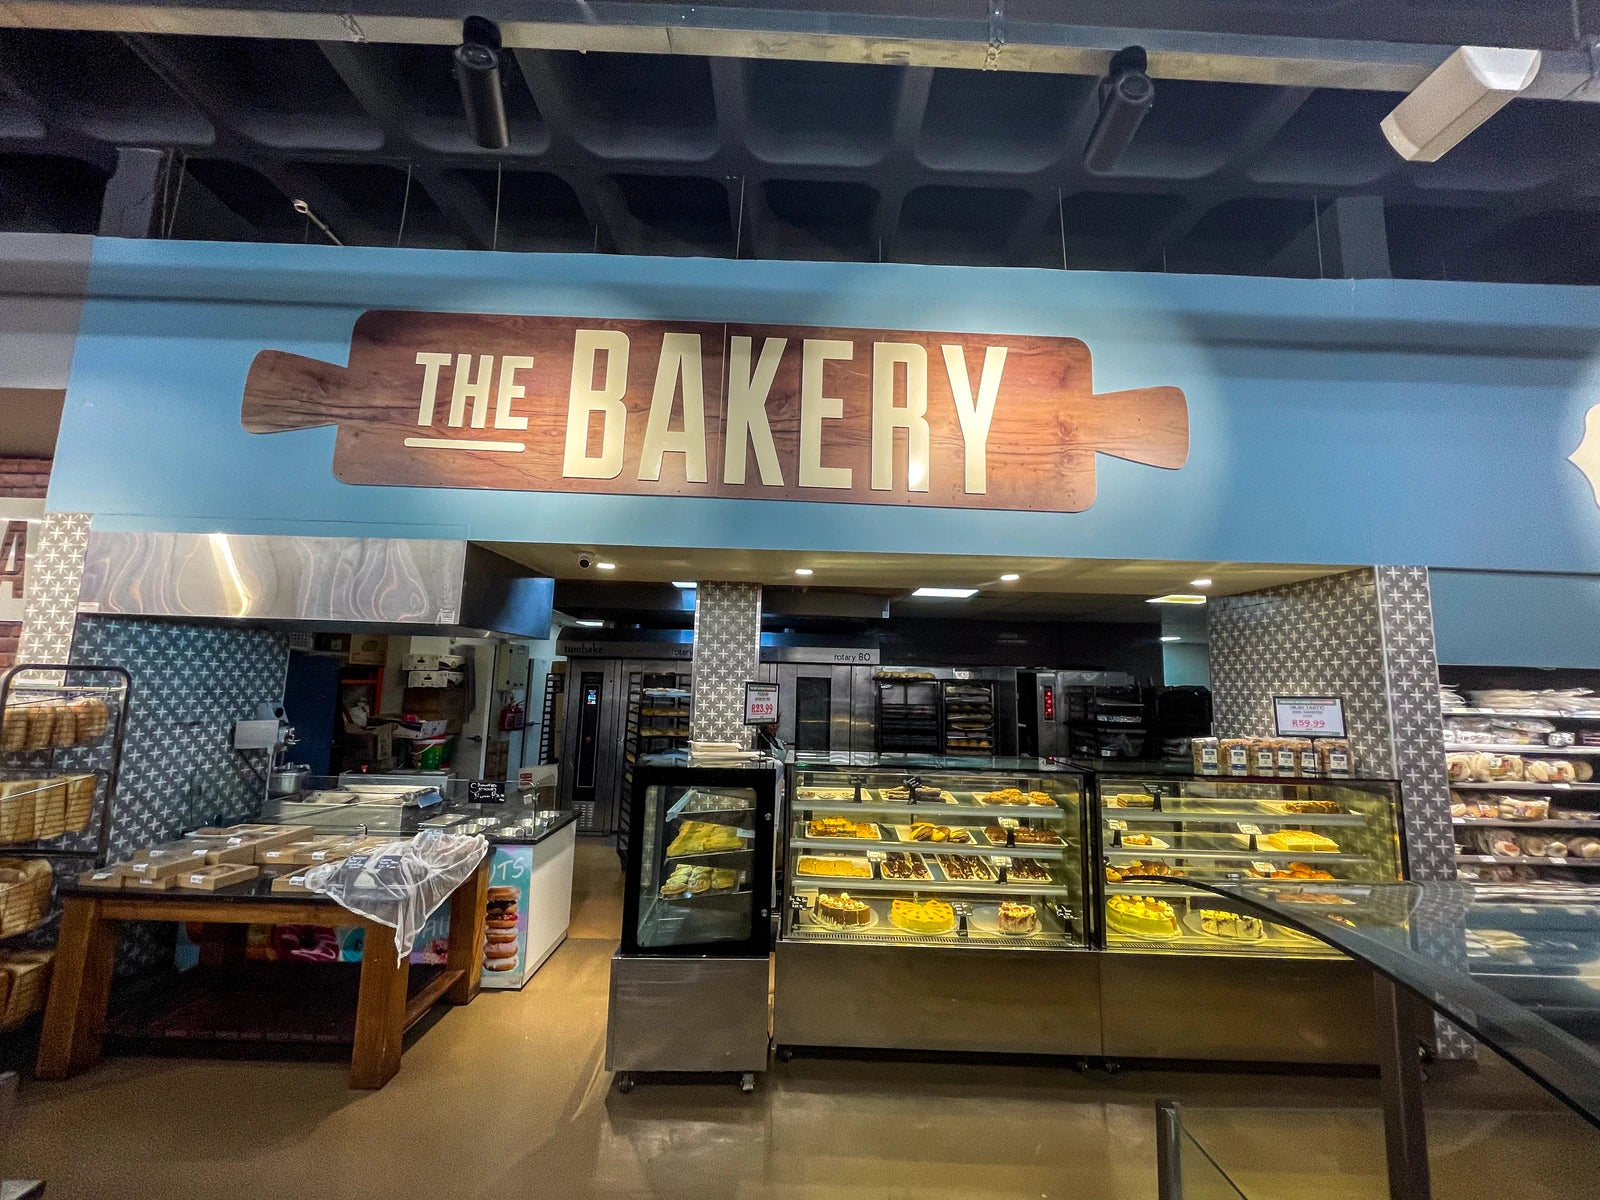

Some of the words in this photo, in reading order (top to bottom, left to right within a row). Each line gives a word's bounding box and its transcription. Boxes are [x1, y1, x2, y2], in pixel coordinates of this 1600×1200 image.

[415, 352, 534, 430] THE
[562, 329, 1008, 494] BAKERY
[834, 653, 856, 662] rotary
[858, 652, 871, 661] 80
[751, 703, 773, 714] R23.99
[1292, 719, 1326, 728] R59.99
